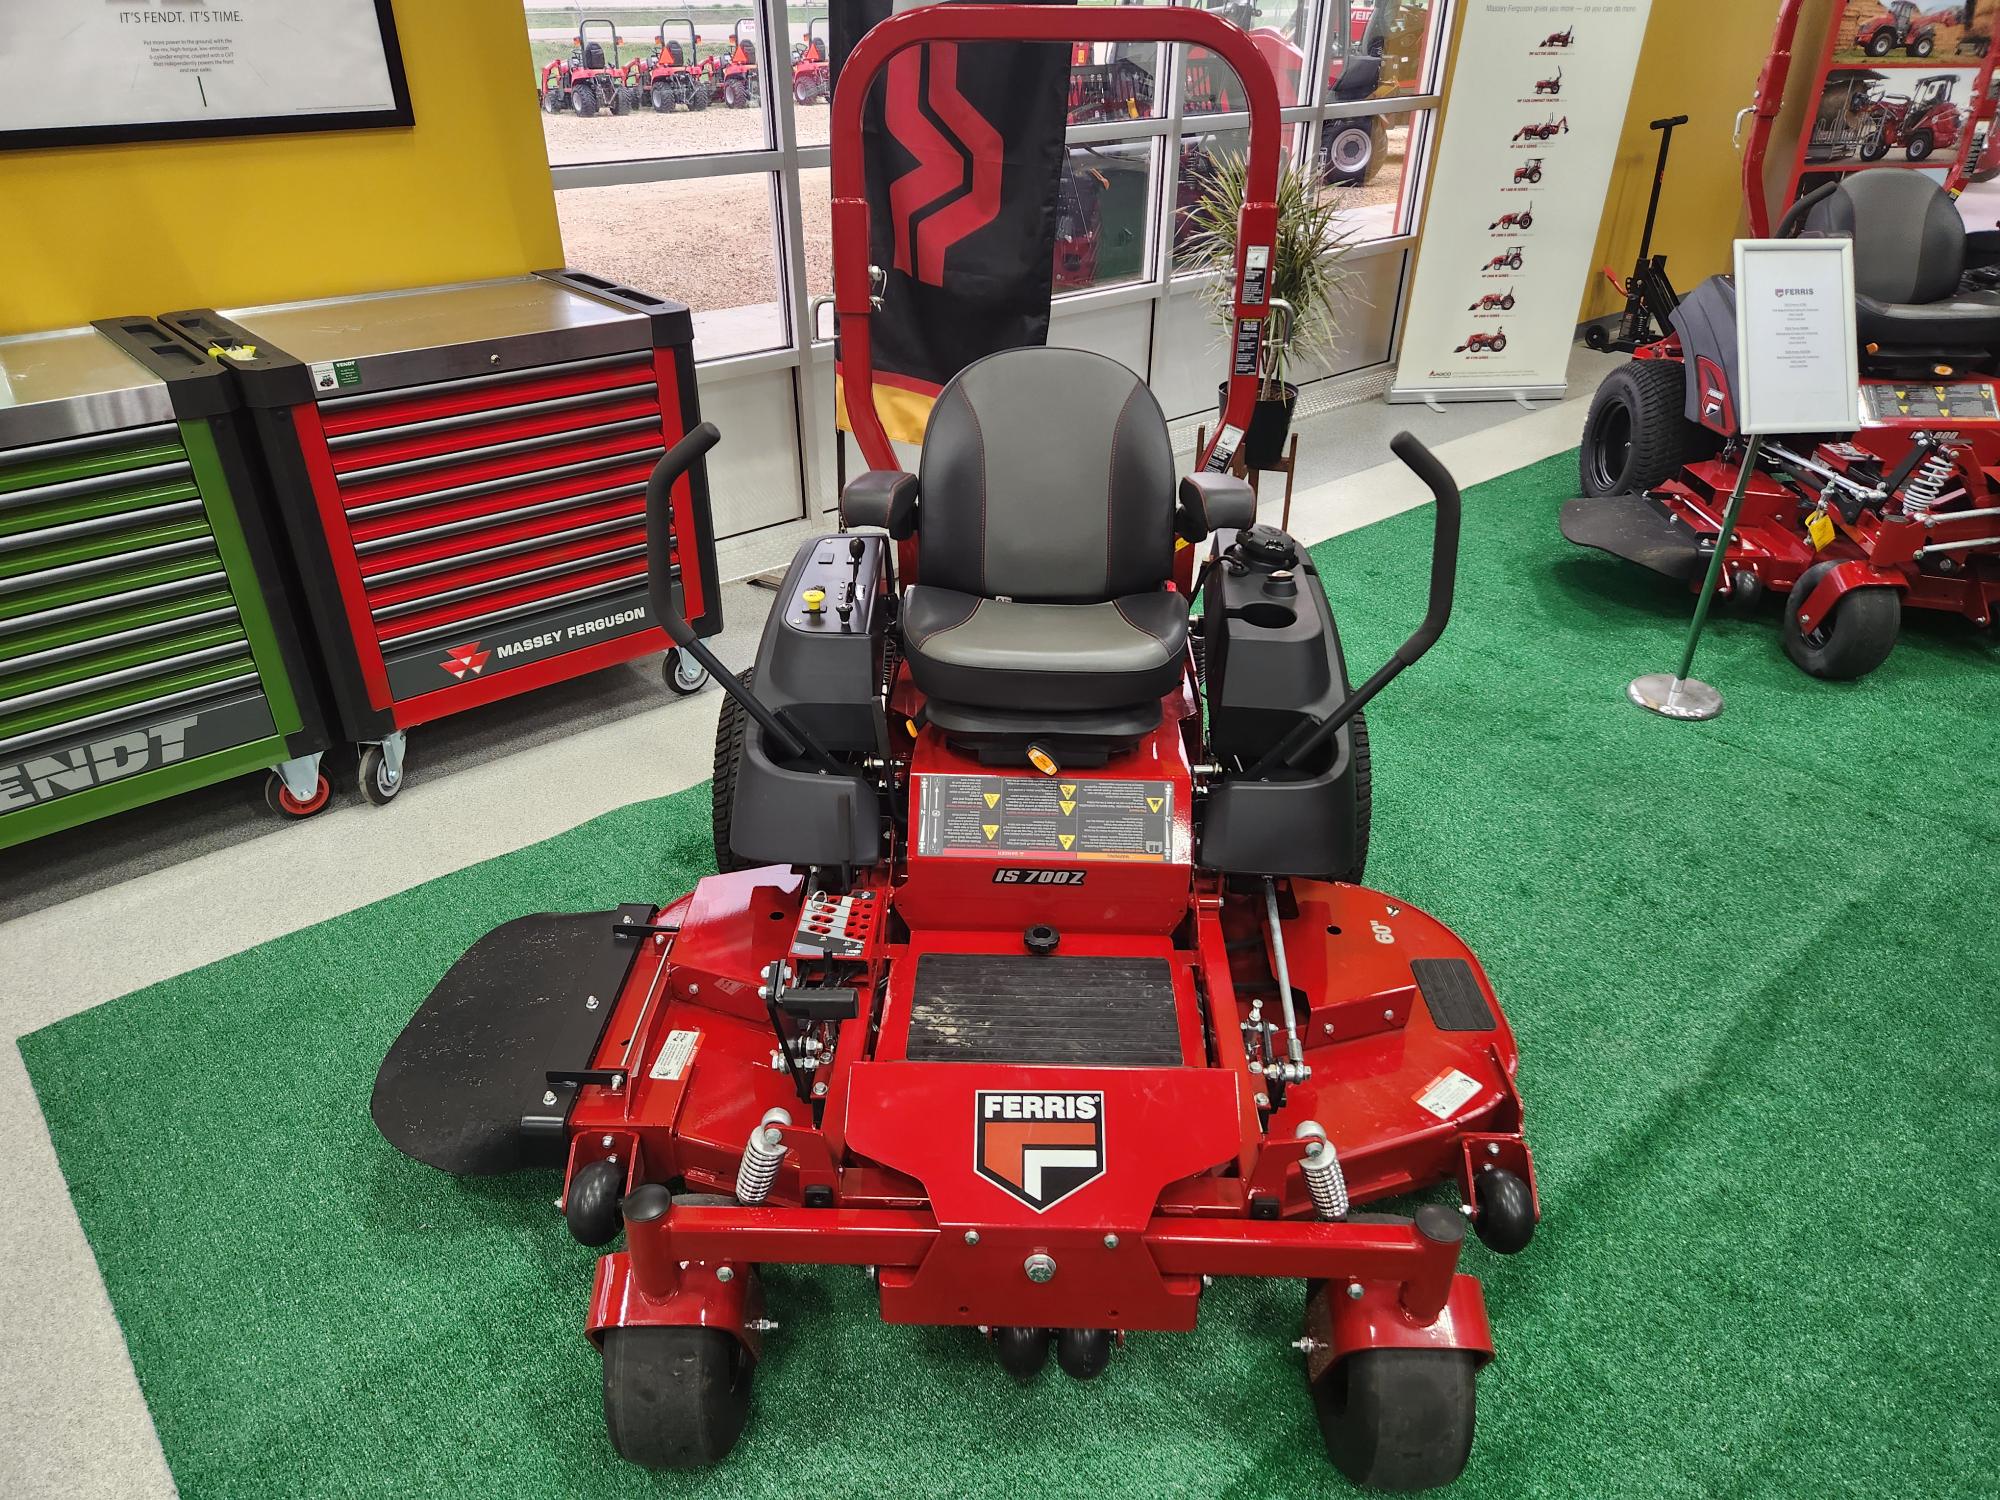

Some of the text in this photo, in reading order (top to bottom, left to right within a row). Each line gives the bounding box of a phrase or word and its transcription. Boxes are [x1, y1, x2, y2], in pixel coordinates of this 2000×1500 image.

[144, 11, 185, 23] FENDT.
[190, 11, 210, 23] IT'S
[212, 10, 243, 22] TIME.
[1785, 288, 1814, 296] FERRIS
[497, 606, 646, 659] MASSEY FERGUSON
[0, 715, 198, 814] ENDT
[995, 869, 1085, 884] IS 700Z
[1369, 920, 1395, 944] 60"
[984, 1095, 1097, 1119] FERRIS
